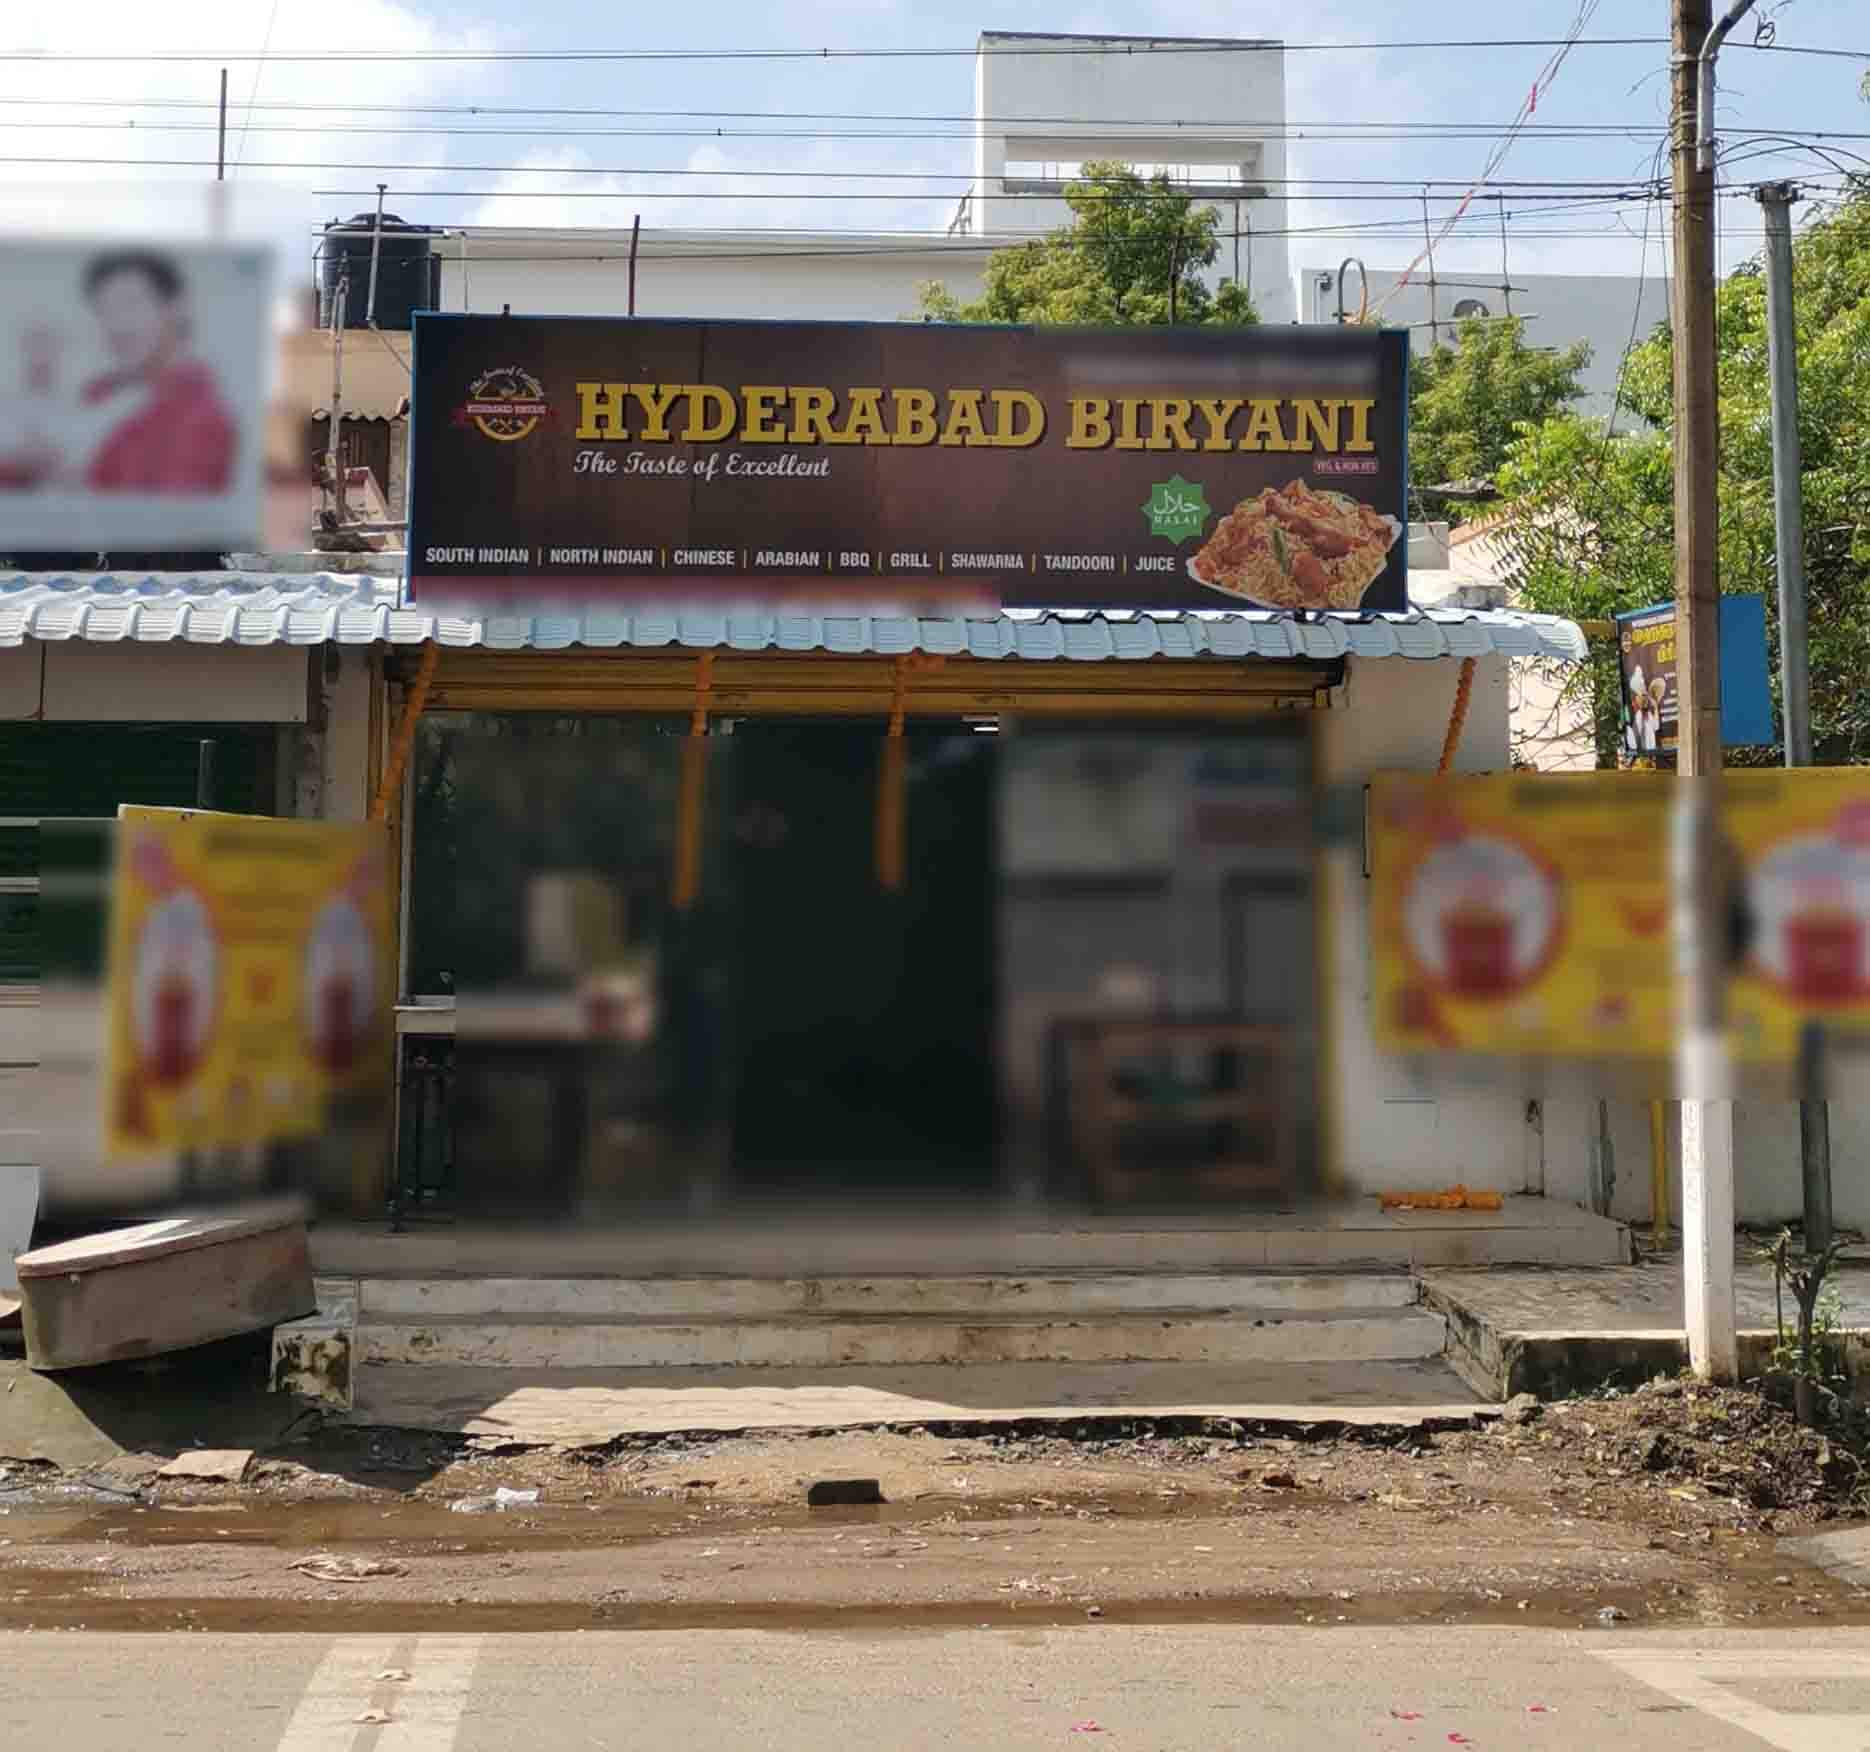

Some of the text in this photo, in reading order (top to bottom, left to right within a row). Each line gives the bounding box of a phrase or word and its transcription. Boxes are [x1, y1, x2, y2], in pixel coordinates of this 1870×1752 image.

[575, 382, 1377, 452] HYDERABAD BIRYANI
[574, 450, 832, 481] The Taste of Excellent
[425, 547, 1176, 572] SOUTH INDIAN NORTH INDIAN CHINESE ARABIAN BBQ GRILL SHAWARMA TANDOORI JUICE
